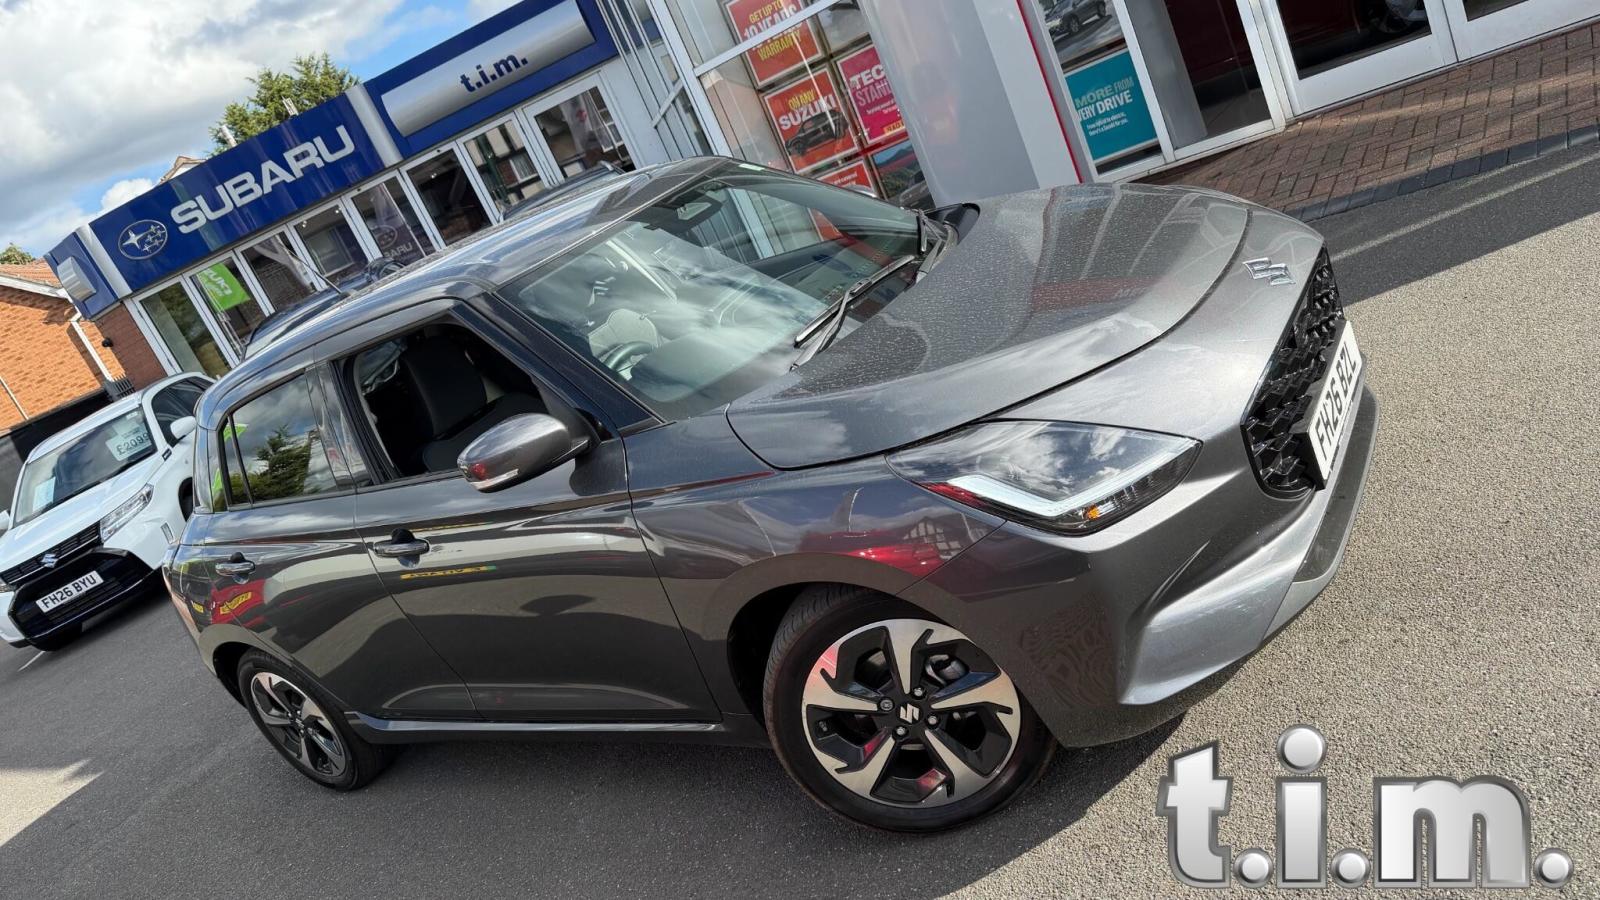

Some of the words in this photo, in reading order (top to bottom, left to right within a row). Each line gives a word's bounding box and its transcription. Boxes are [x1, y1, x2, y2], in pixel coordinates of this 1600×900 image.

[748, 9, 763, 24] GET
[762, 4, 773, 17] UP
[771, 0, 783, 11] TO
[757, 29, 802, 61] WARRANTY
[460, 55, 529, 93] t.i.m.
[788, 94, 801, 110] ON
[799, 89, 816, 106] ANY
[1074, 84, 1115, 109] MORE
[1113, 76, 1135, 94] FROM
[1095, 90, 1133, 115] DRIVE
[779, 94, 838, 130] SUZUKI
[170, 124, 355, 234] SUBARU
[1315, 377, 1343, 461] FH26
[1336, 341, 1356, 398] BZL
[41, 587, 74, 609] FH26
[72, 574, 97, 592] BYU
